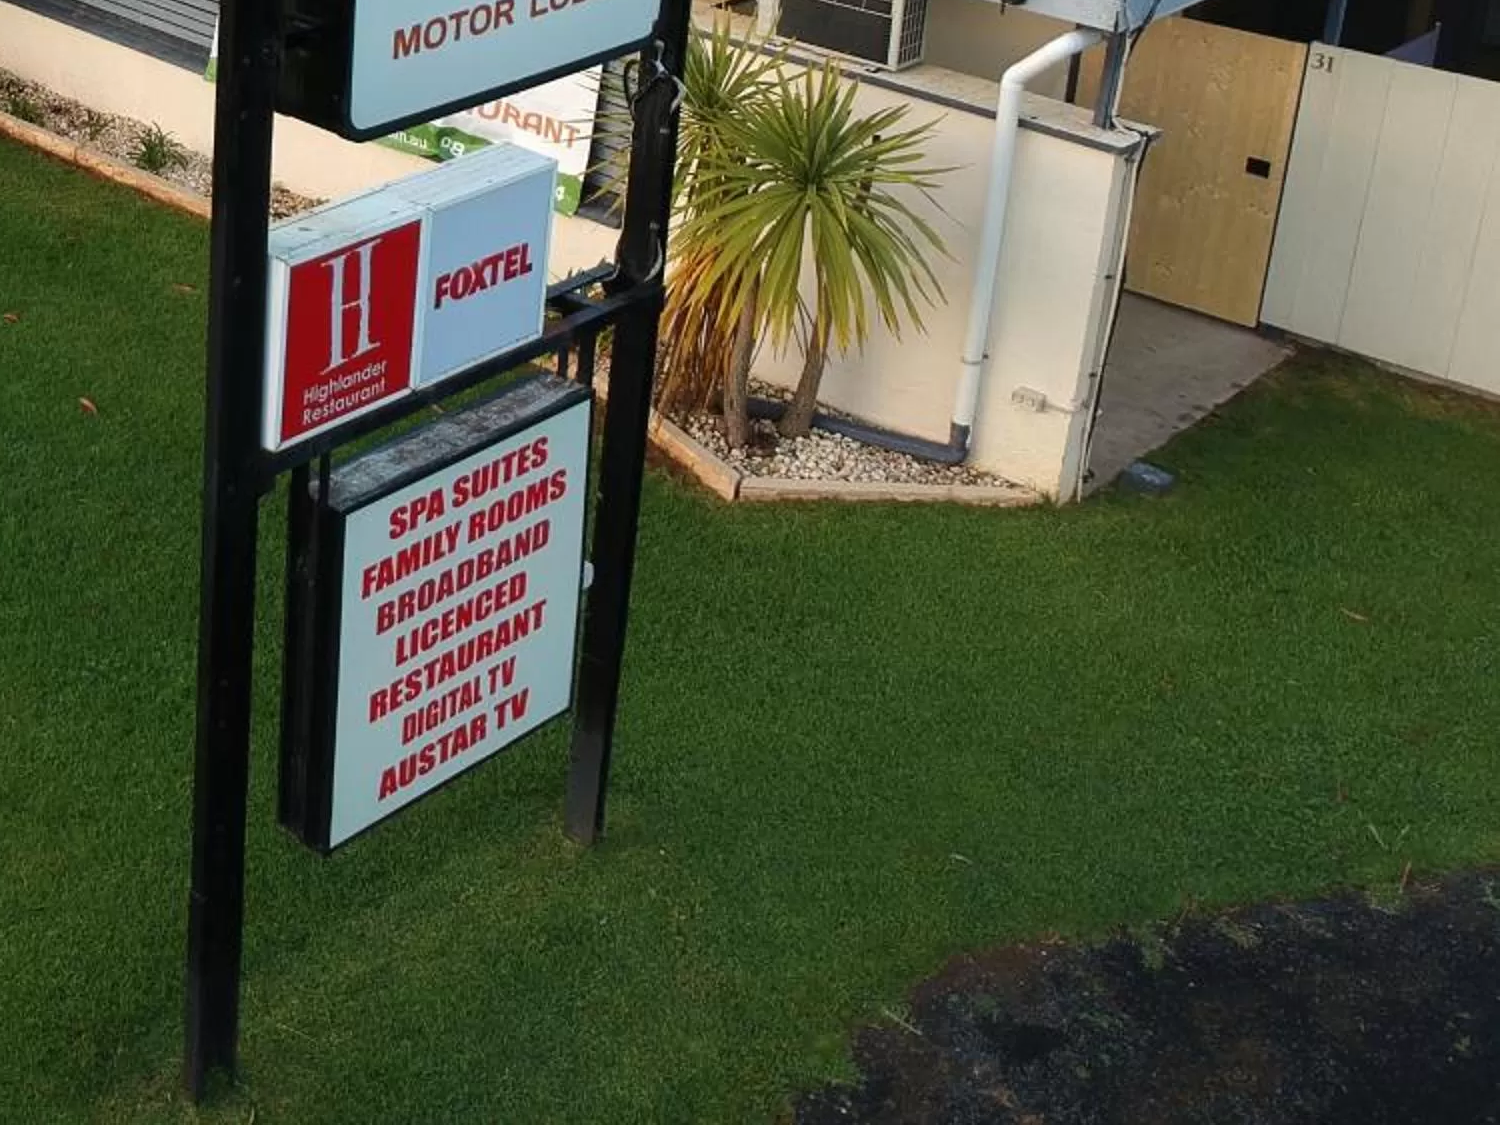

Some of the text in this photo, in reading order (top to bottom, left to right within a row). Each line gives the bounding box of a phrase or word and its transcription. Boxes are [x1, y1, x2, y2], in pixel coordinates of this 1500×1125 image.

[1311, 53, 1335, 73] 31
[465, 101, 581, 148] URANT
[320, 238, 383, 375] H
[434, 243, 533, 310] FOXTEL
[302, 378, 386, 426] Restaurant
[303, 360, 388, 406] Highlander
[361, 468, 567, 600] FAMILY ROOMS
[389, 436, 548, 540] SPA SUITES
[376, 519, 551, 635] BROADBAND
[395, 571, 527, 667] LICENCED
[368, 599, 547, 724] RESTAURANT
[401, 656, 516, 746] DIGITAL TV
[378, 688, 529, 801] AUSTAR TV
